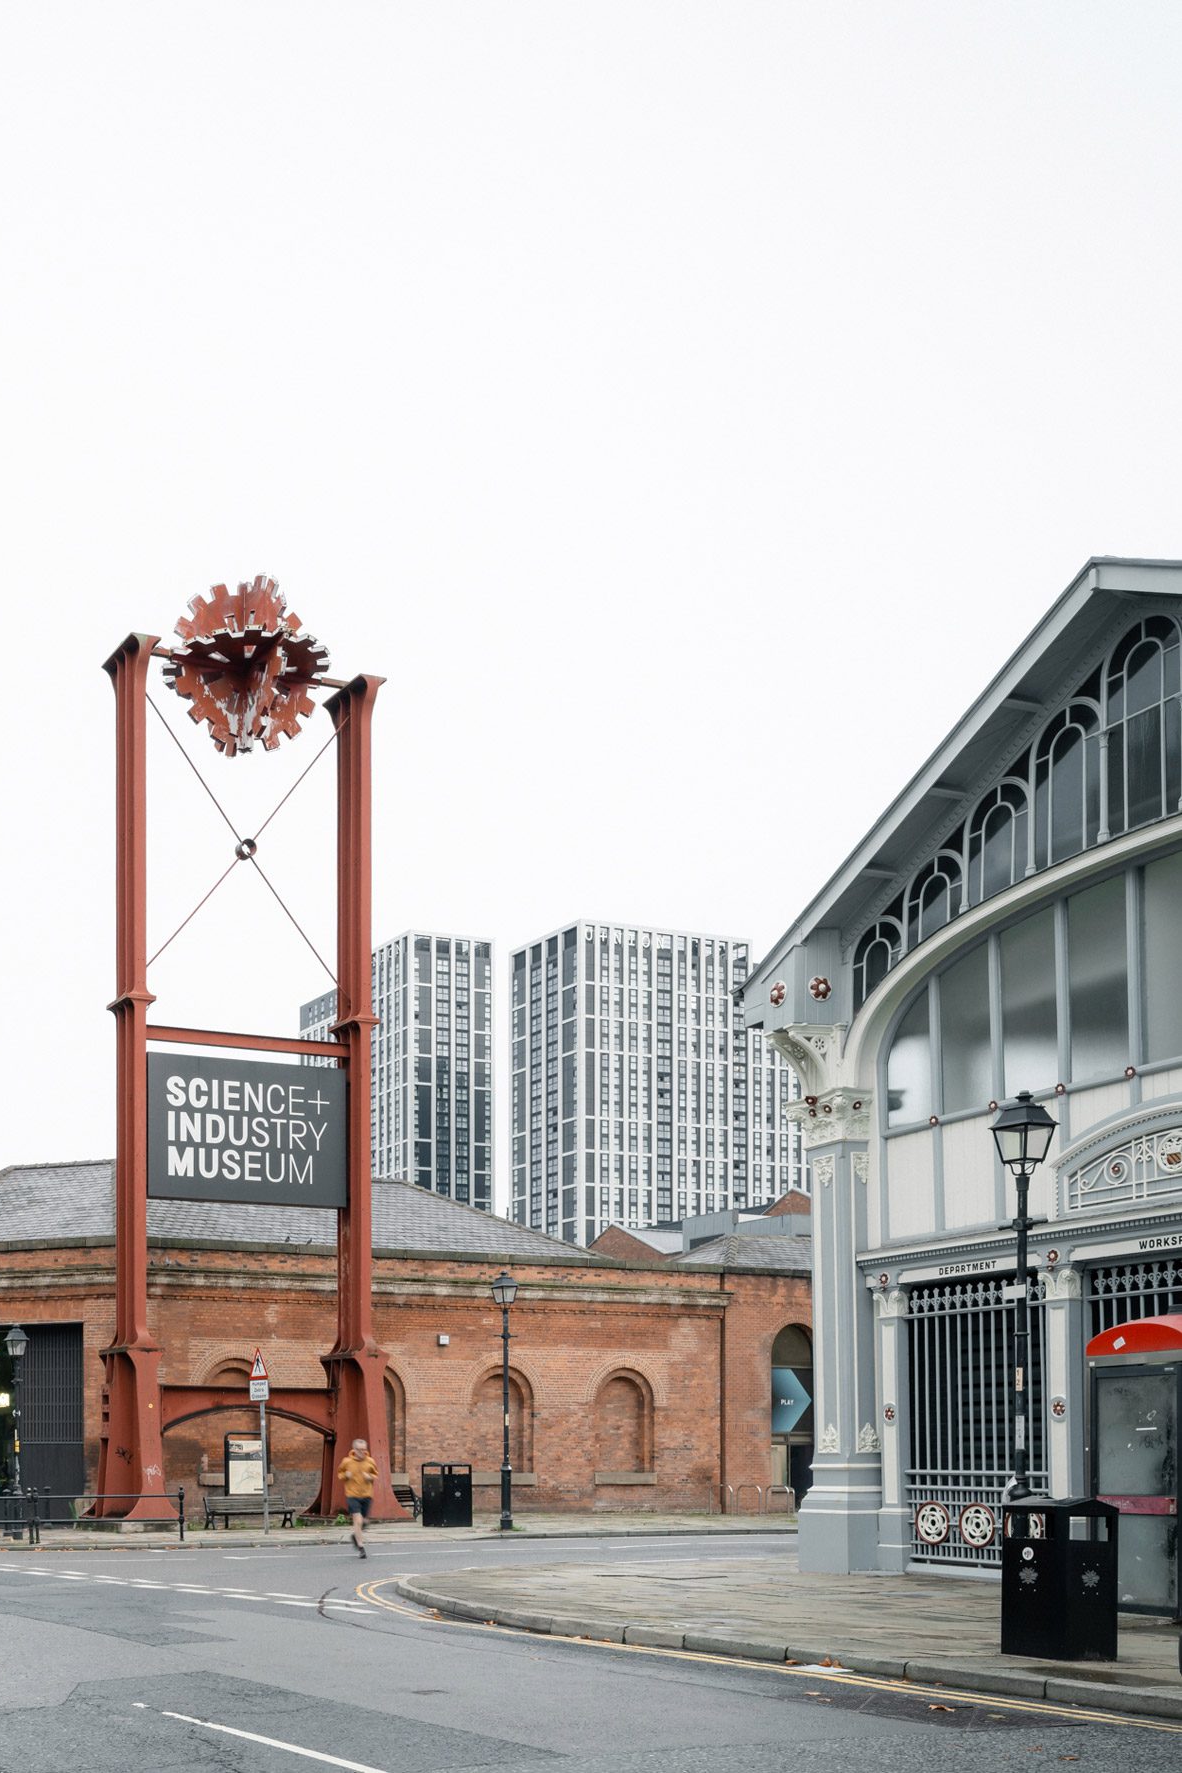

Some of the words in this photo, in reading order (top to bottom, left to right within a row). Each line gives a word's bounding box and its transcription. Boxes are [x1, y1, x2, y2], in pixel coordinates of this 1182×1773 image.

[168, 1110, 328, 1151] INDUSTRY
[168, 1145, 313, 1185] MUSEUM
[939, 1260, 997, 1276] DEPARTMENT
